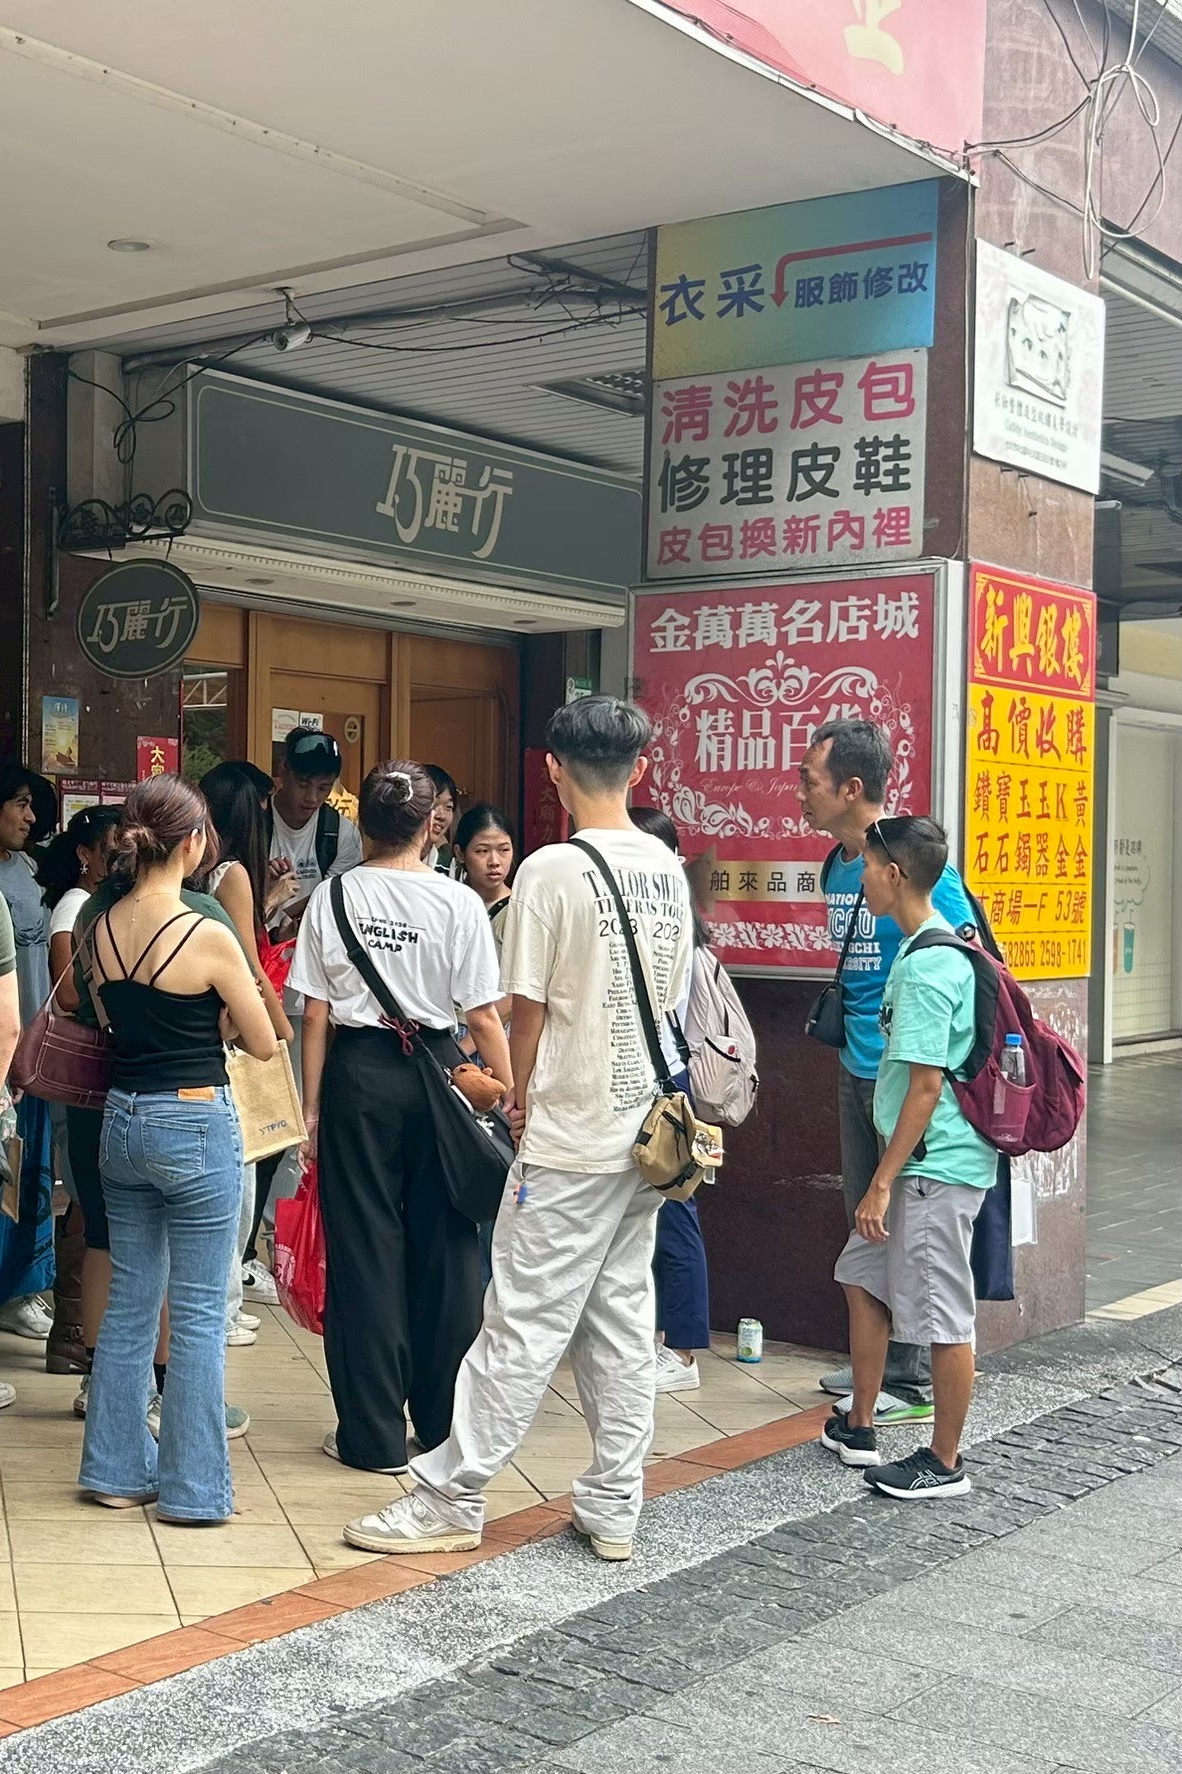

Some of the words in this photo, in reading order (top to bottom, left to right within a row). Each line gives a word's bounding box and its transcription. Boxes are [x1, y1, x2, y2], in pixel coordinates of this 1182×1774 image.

[659, 262, 766, 327] 衣采
[794, 260, 930, 308] 服飾修改
[661, 361, 917, 445] 清洗皮包
[658, 434, 911, 514] 修理皮鞋
[657, 506, 912, 567] 皮包換新內裡
[649, 591, 919, 654] 金萬萬名店城
[980, 583, 1084, 686] 新興銀樓
[301, 717, 319, 727] Wi-Fi
[694, 703, 864, 773] 精品百
[977, 690, 1087, 767] 高價收購
[368, 938, 403, 953] CAMP
